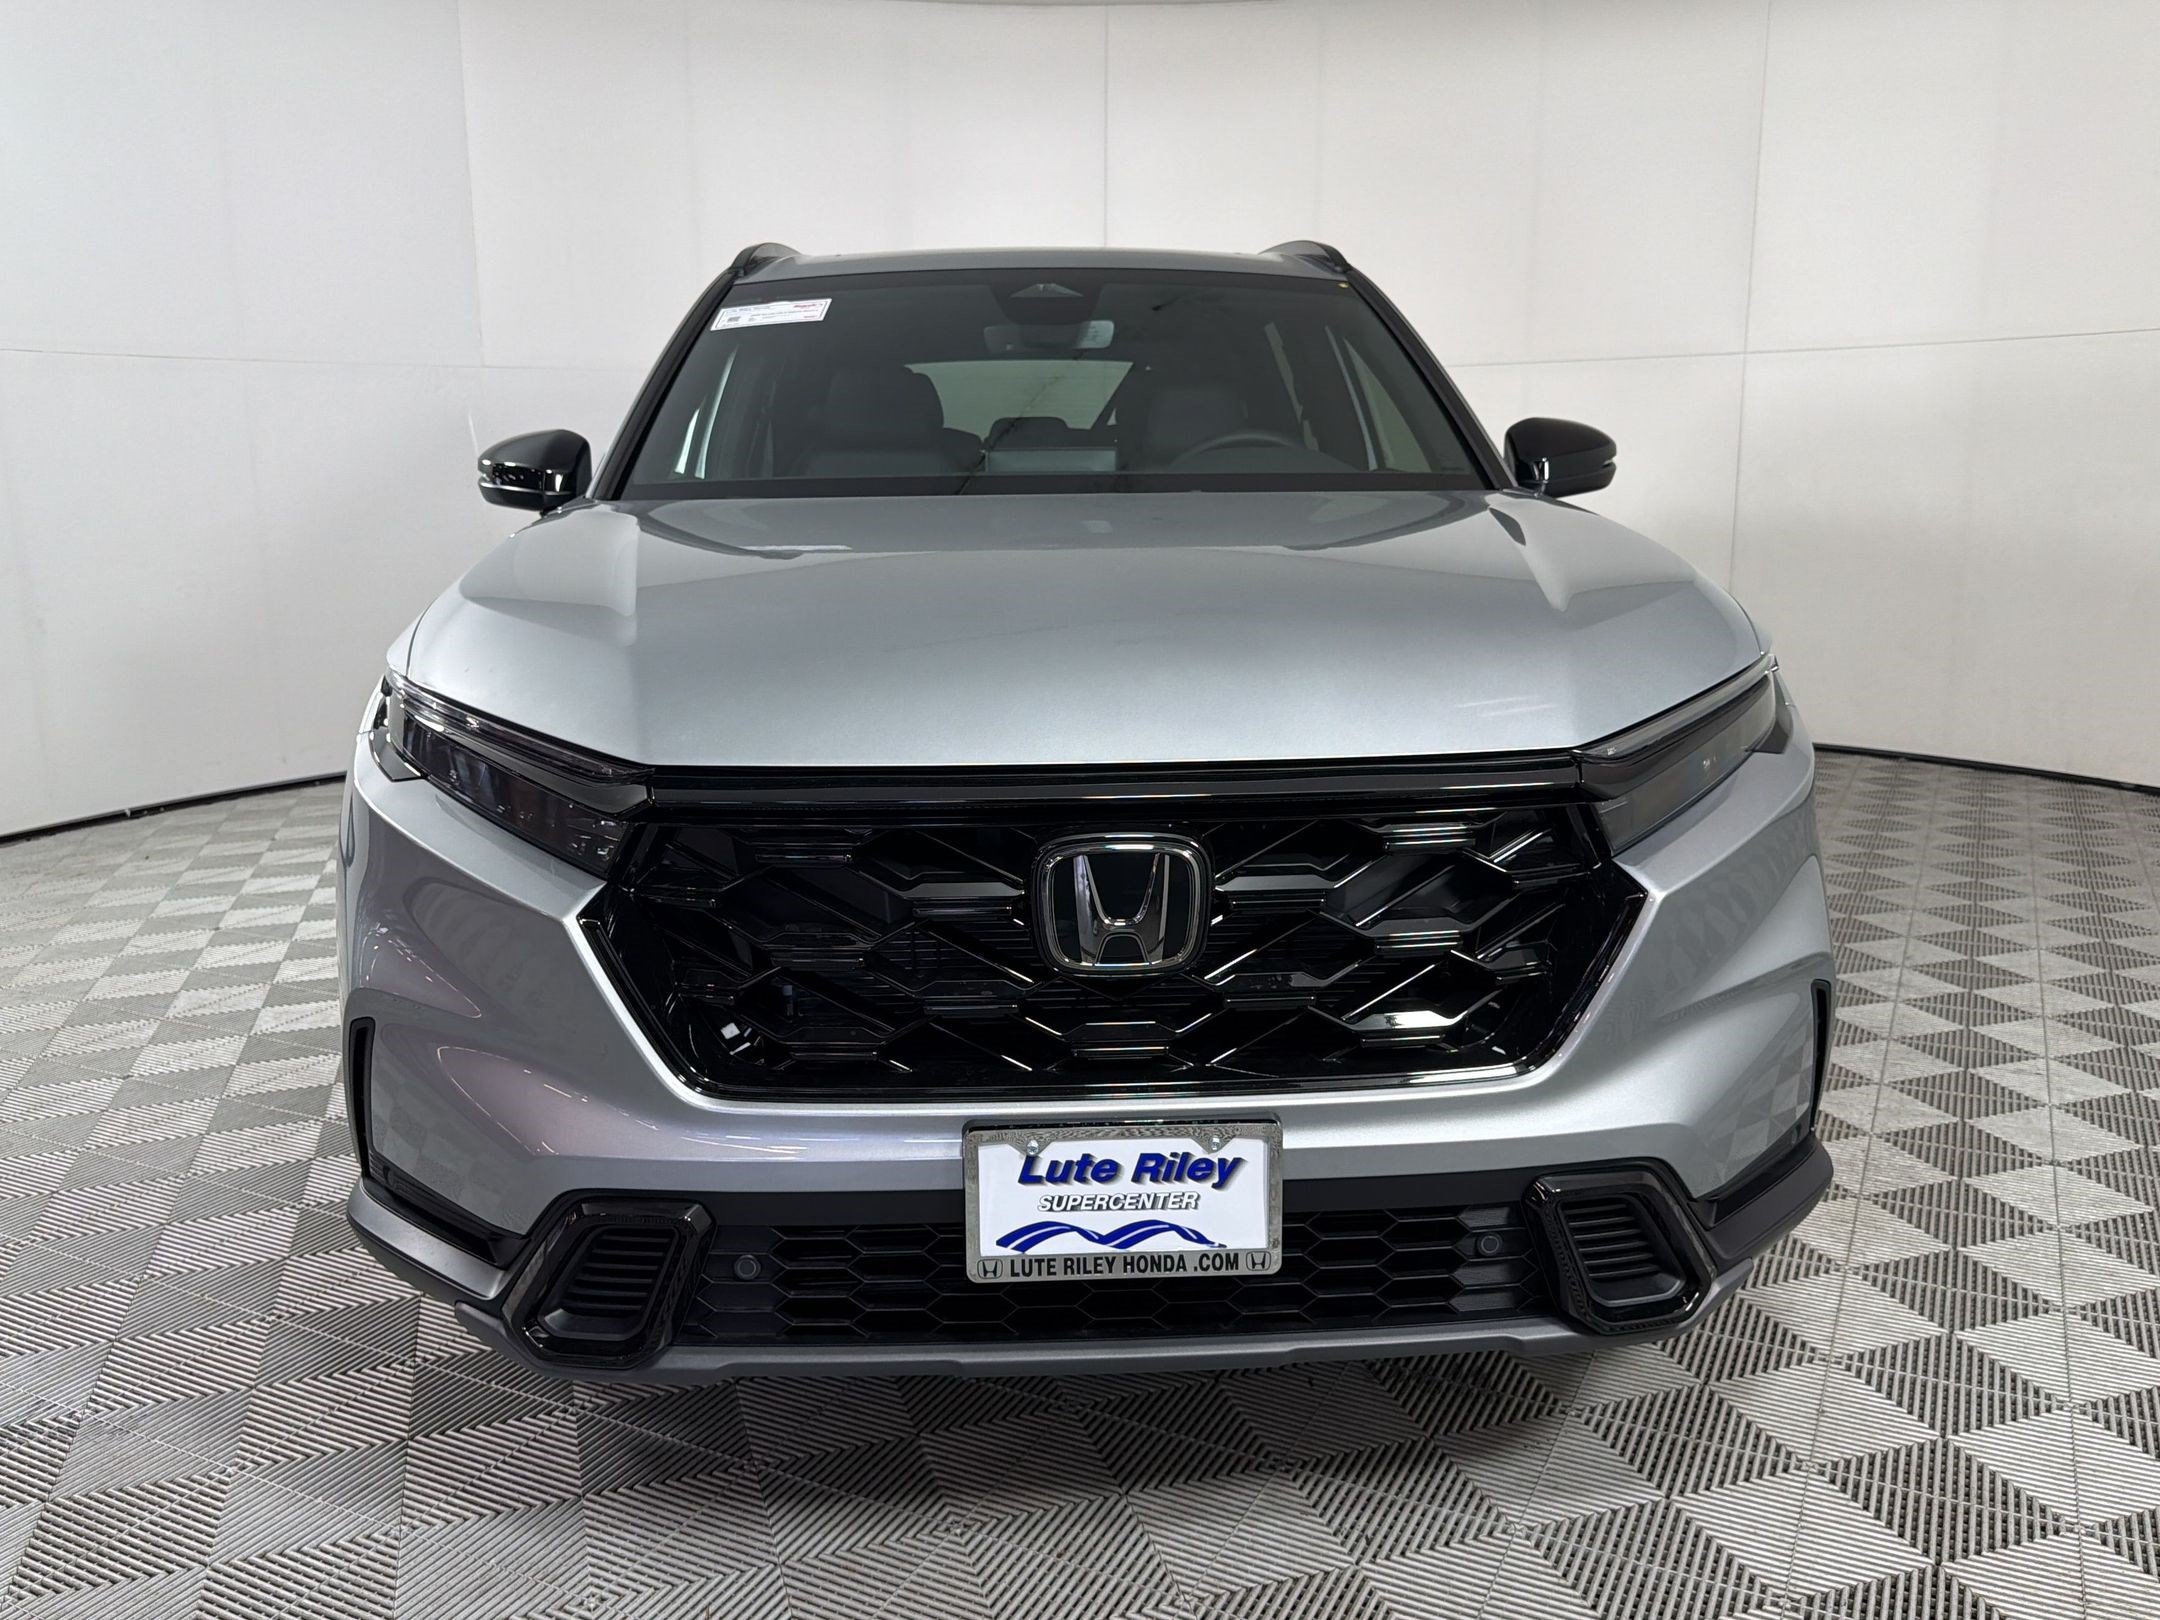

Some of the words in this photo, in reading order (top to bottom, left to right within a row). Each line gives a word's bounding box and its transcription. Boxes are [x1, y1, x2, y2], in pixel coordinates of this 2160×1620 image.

[1018, 1153, 1119, 1185] Lute
[1131, 1151, 1244, 1188] Riley
[1038, 1190, 1200, 1212] SUPERCENTER
[1010, 1258, 1057, 1277] LUTE
[1065, 1256, 1117, 1276] RILEY
[1123, 1252, 1187, 1274] HONDA
